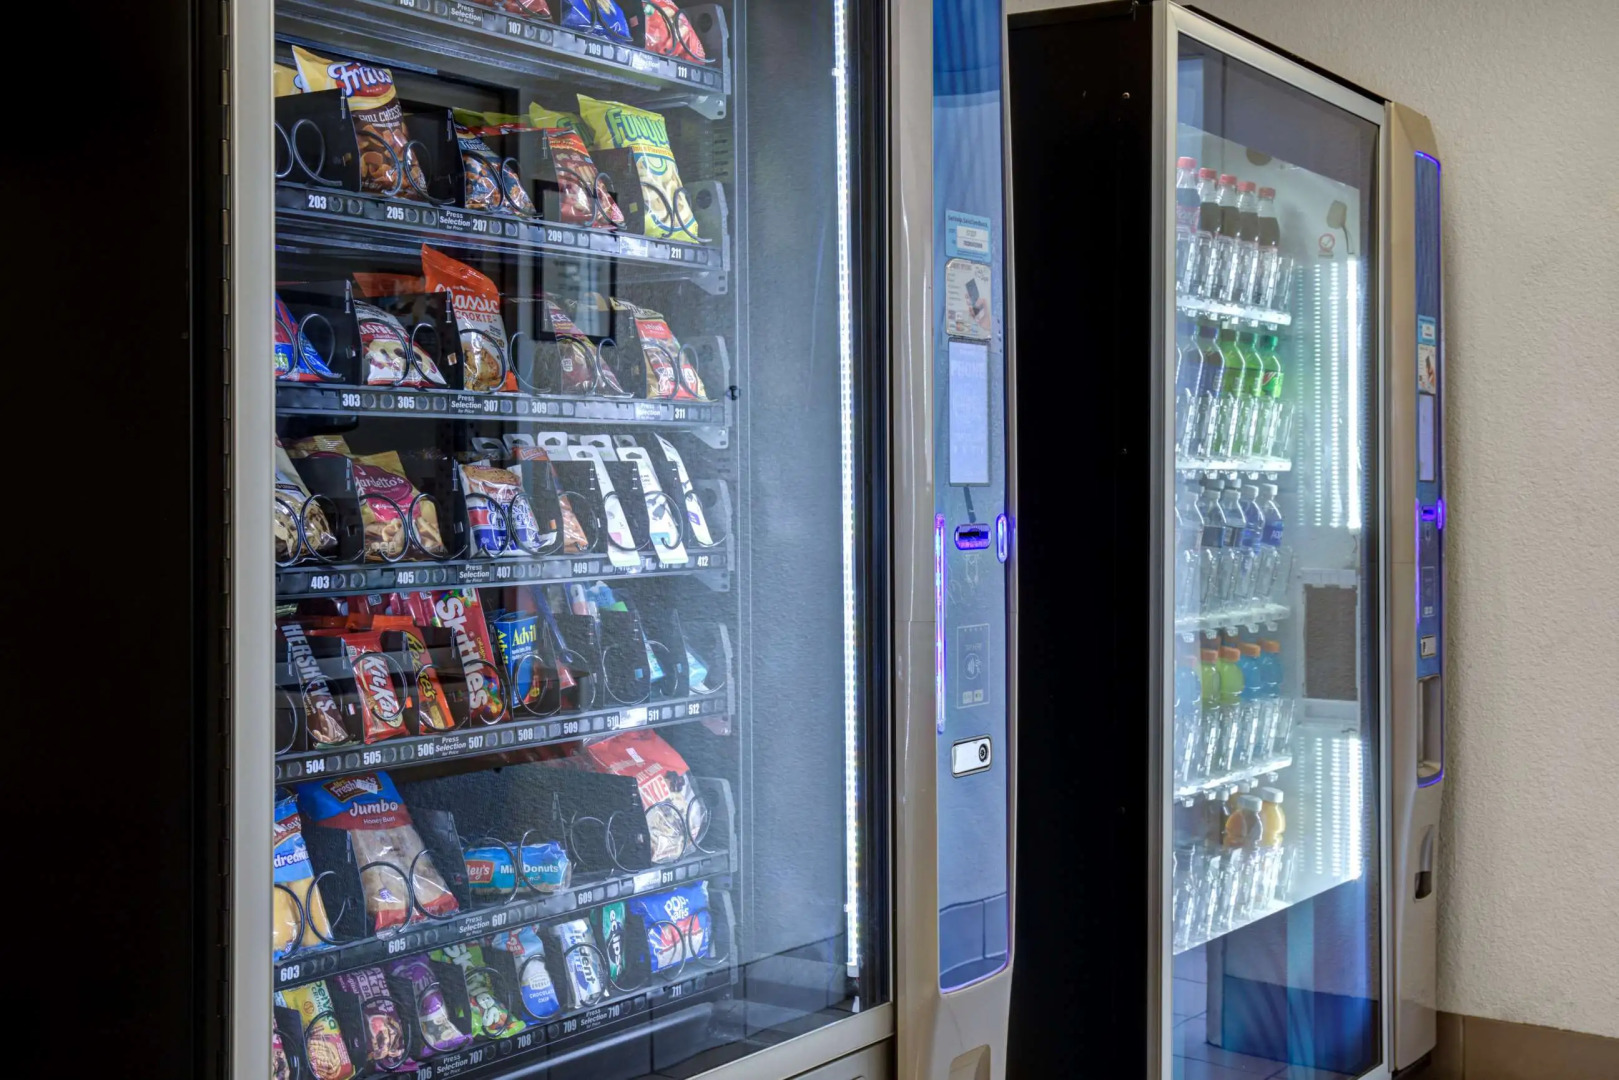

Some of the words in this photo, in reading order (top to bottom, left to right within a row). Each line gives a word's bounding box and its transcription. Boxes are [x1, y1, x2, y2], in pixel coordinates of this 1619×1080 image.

[451, 8, 482, 21] Selection
[457, 3, 474, 13] Press
[508, 21, 521, 35] 107
[588, 43, 601, 56] 109
[678, 66, 688, 79] 111
[606, 107, 671, 148] FUNYU
[308, 195, 327, 209] 203
[386, 206, 404, 220] 205
[446, 210, 463, 219] Press
[440, 215, 471, 227] Selection
[472, 219, 487, 232] 207
[547, 230, 562, 242] 209
[671, 247, 682, 259] 211
[342, 394, 360, 408] 303
[397, 396, 415, 409] 305
[451, 400, 482, 409] Selection
[484, 400, 499, 413] 307
[531, 401, 547, 414] 309
[675, 408, 686, 419] 311
[573, 562, 588, 574] 409
[697, 556, 709, 567] 412
[397, 571, 415, 584] 405
[459, 569, 490, 578] Selection
[496, 566, 511, 578] 407
[310, 576, 330, 589] 403
[512, 624, 538, 647] Advil
[436, 597, 488, 710] Skittles
[281, 623, 337, 712] HERSHEY'S
[406, 632, 437, 700] Reese's
[648, 709, 660, 721] 511
[688, 703, 700, 715] 512
[563, 721, 578, 734] 509
[606, 716, 620, 728] 510
[441, 736, 459, 744] Press
[518, 728, 533, 741] 508
[435, 742, 467, 753] Selection
[468, 735, 484, 749] 507
[417, 743, 434, 757] 506
[363, 751, 381, 765] 505
[306, 759, 325, 774] 504
[350, 799, 398, 817] Jumbo
[524, 864, 559, 874] Donuts
[662, 871, 673, 884] 611
[578, 890, 593, 904] 609
[465, 915, 482, 924] Press
[492, 913, 507, 927] 607
[459, 920, 490, 933] Selection
[388, 937, 406, 954] 605
[280, 965, 299, 982] 603
[671, 985, 682, 997] 711
[586, 1009, 601, 1017] Press
[608, 1005, 620, 1018] 710
[580, 1013, 608, 1027] Selection
[563, 1020, 577, 1034] 709
[517, 1034, 532, 1049] 708
[443, 1054, 461, 1064] Press
[469, 1050, 483, 1065] 707
[436, 1059, 468, 1073] Selection
[416, 1067, 433, 1080] 706
